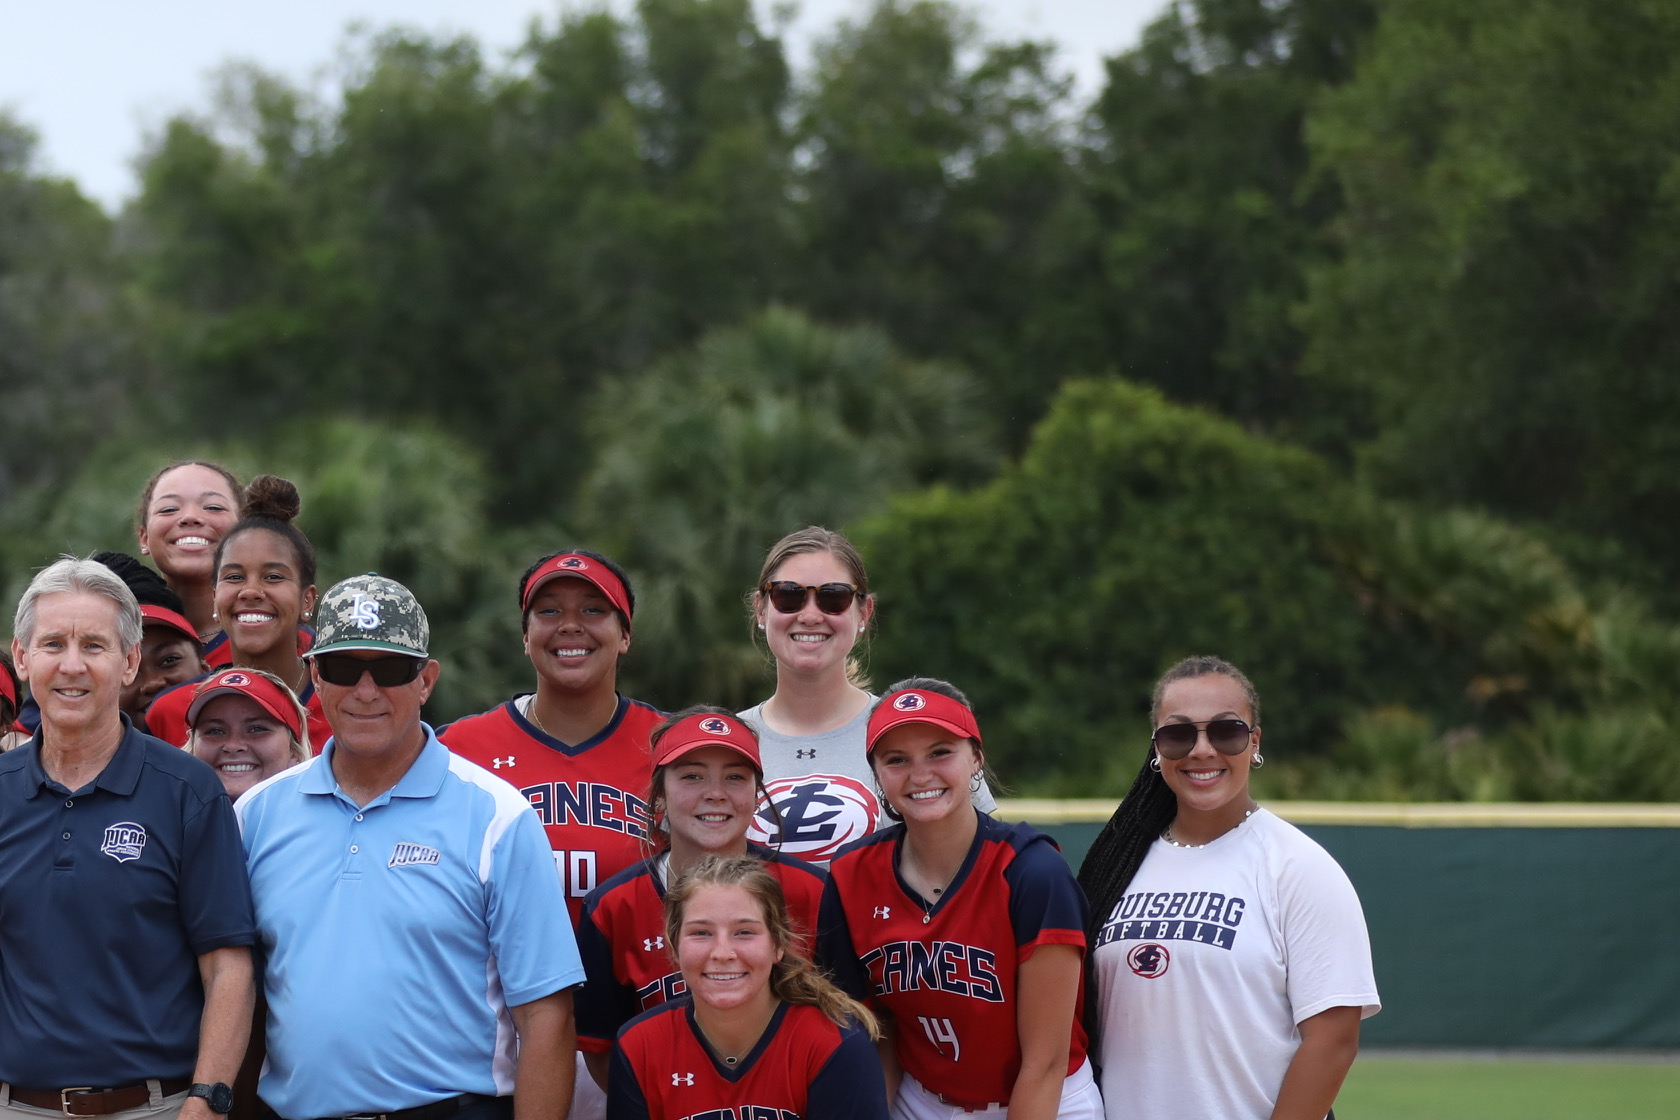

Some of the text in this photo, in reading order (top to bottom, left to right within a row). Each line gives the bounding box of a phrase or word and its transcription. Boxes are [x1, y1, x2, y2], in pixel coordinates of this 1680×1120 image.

[349, 593, 381, 630] LS
[103, 829, 146, 849] NJCAA
[389, 844, 440, 866] NJCAA
[1103, 891, 1246, 928] OUISBURG
[918, 1016, 960, 1062] 14
